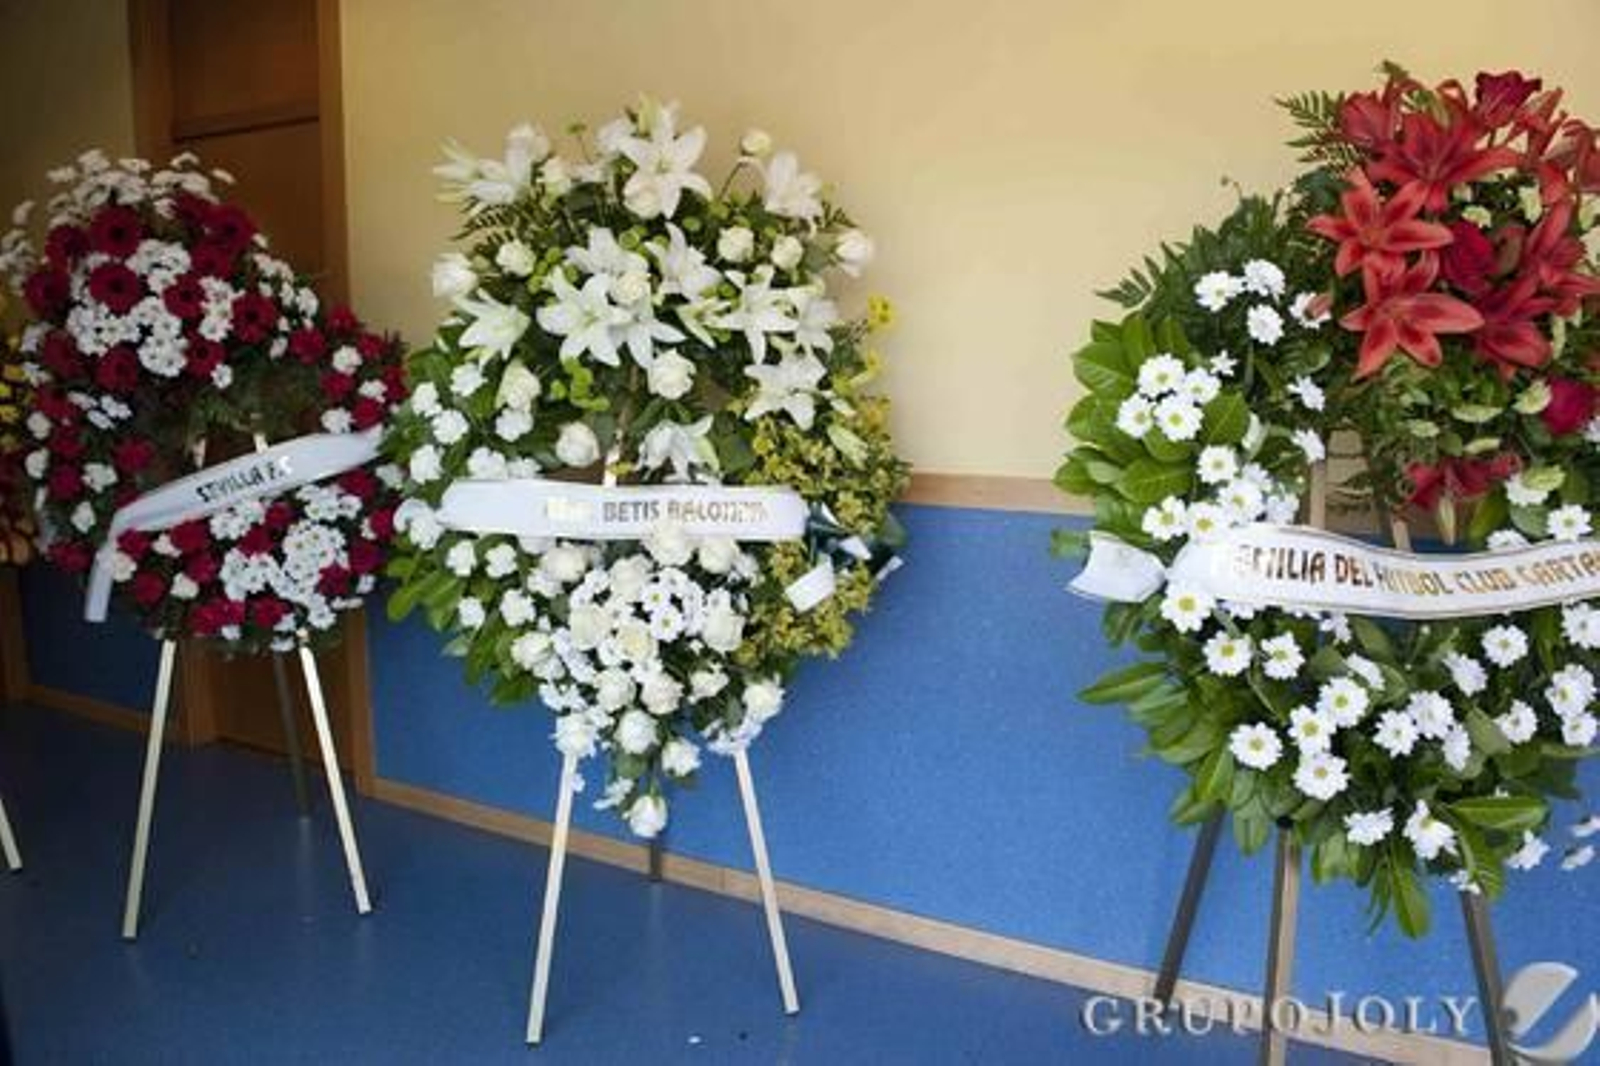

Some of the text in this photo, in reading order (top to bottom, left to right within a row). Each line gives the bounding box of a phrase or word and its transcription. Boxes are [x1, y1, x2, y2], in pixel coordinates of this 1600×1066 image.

[602, 501, 660, 522] BETIS
[1334, 554, 1373, 588] DEL
[1454, 567, 1517, 594] CLUB
